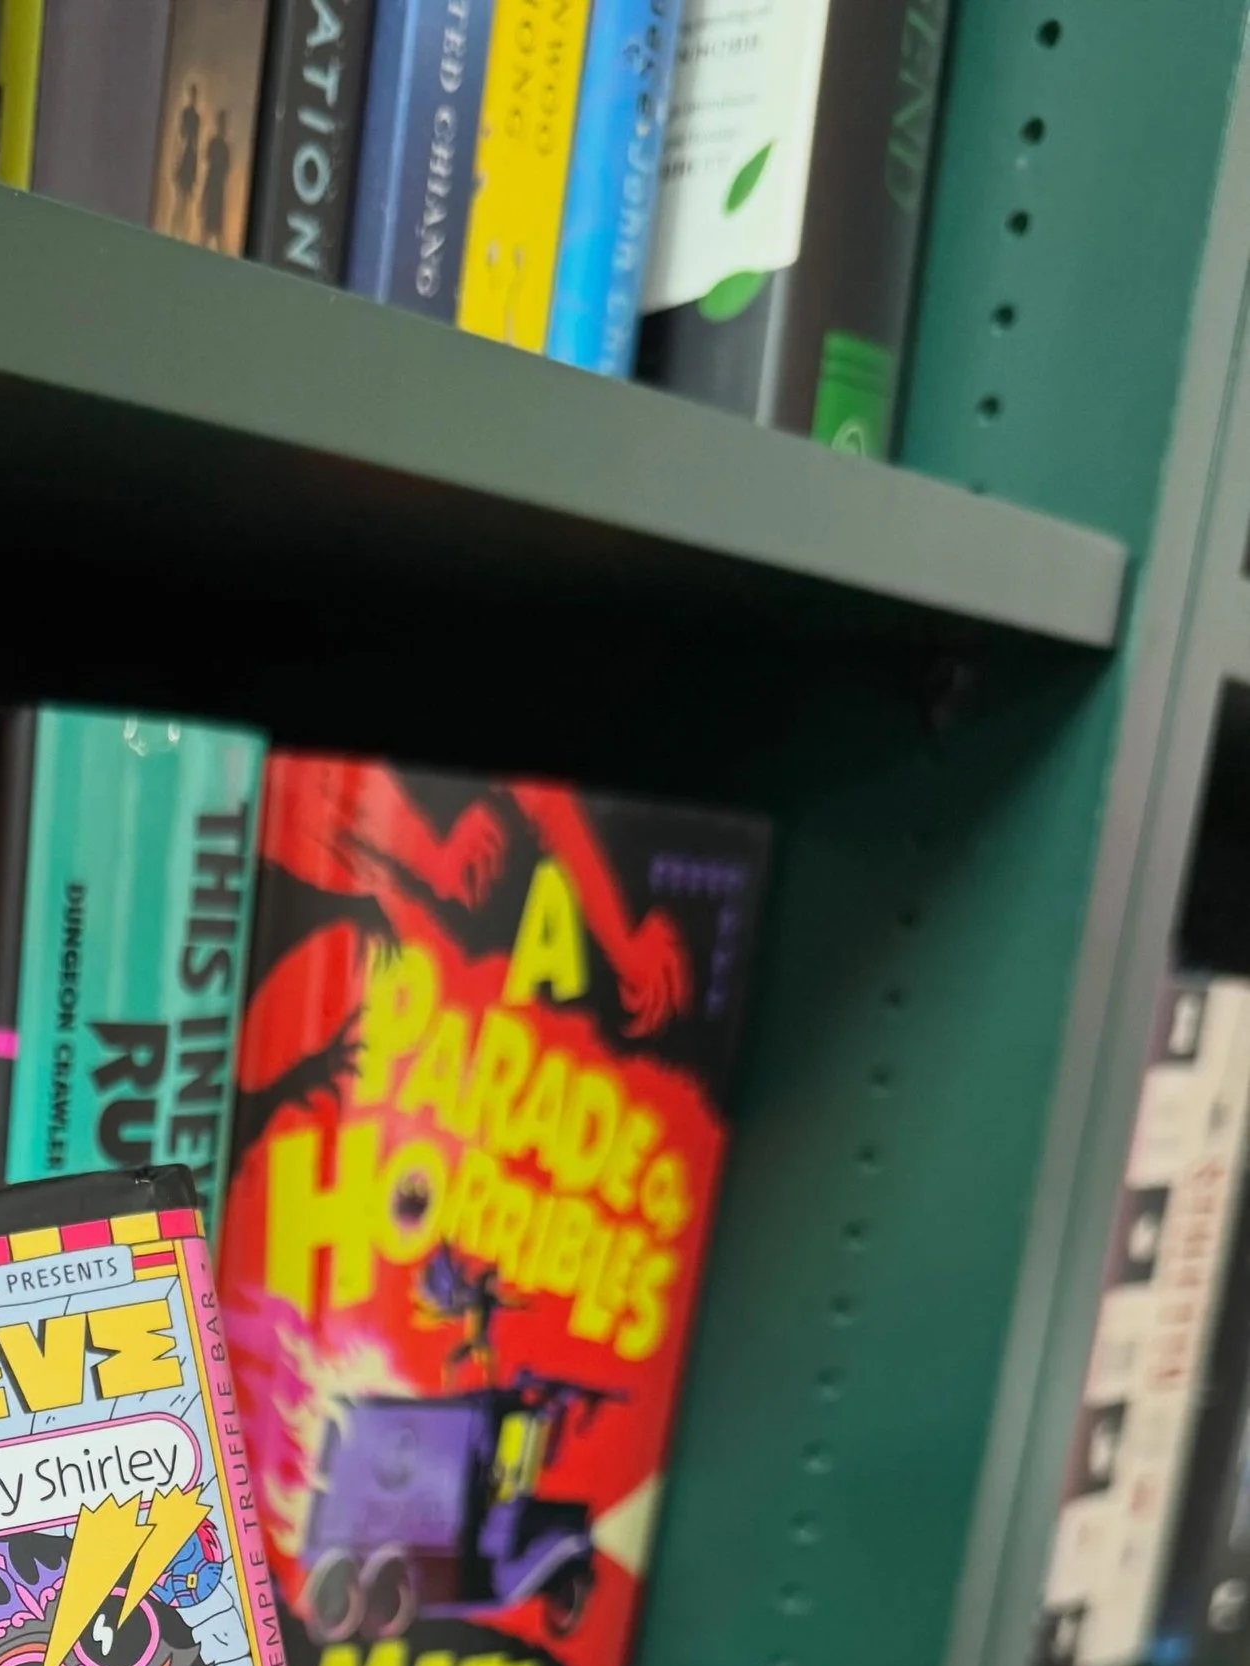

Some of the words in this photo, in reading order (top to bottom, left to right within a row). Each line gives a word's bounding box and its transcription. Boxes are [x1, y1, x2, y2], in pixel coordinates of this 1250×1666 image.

[416, 104, 457, 298] CHIANG
[59, 881, 87, 1032] DUNGEON
[179, 802, 250, 997] THIS
[503, 860, 589, 1006] A
[42, 1040, 73, 1171] CRAWLER
[352, 938, 659, 1212] PARADE
[7, 1257, 117, 1297] PRESENTS
[265, 1122, 674, 1361] HORRIBLES
[200, 1290, 226, 1364] BAR
[34, 1440, 180, 1501] Shirley
[216, 1379, 264, 1536] TRUFFLE
